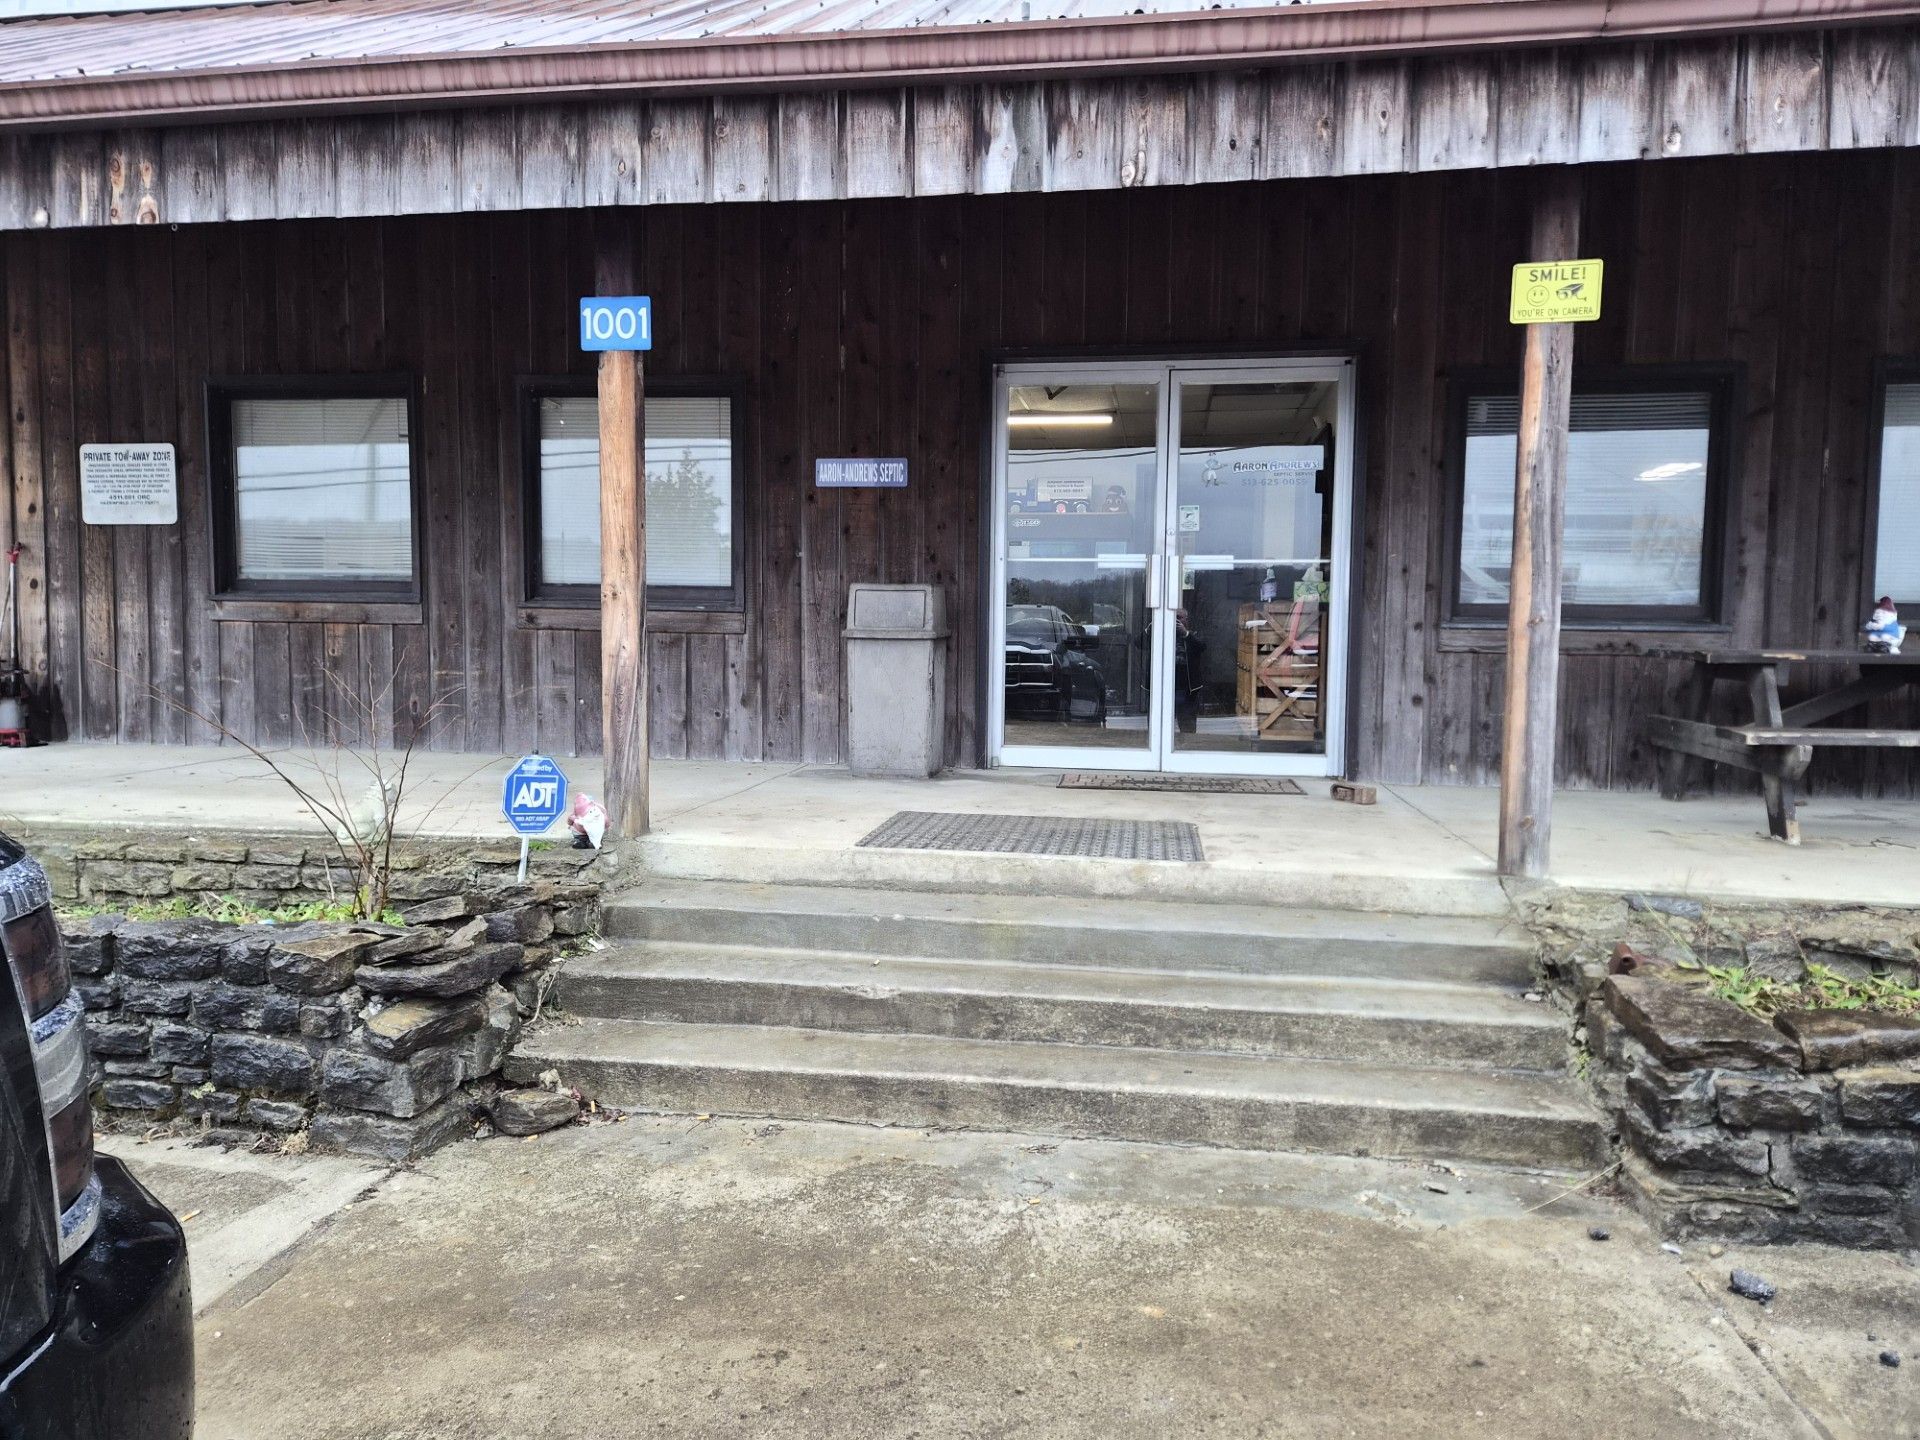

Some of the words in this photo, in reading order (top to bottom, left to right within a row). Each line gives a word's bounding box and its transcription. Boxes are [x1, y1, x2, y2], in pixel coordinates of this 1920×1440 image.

[1529, 267, 1586, 282] SMILE!
[1518, 308, 1544, 318] YOU'RE
[1547, 308, 1559, 316] ON
[1562, 306, 1593, 316] CAMERA
[582, 307, 648, 340] 1001
[83, 452, 111, 462] PRIVATE
[152, 451, 171, 461] ZONE
[819, 462, 878, 482] AARON-ANDREWS
[879, 462, 904, 482] SEPTIC
[1233, 461, 1268, 472] AARON
[1269, 460, 1319, 470] ANDREWS
[512, 781, 558, 808] ADT
